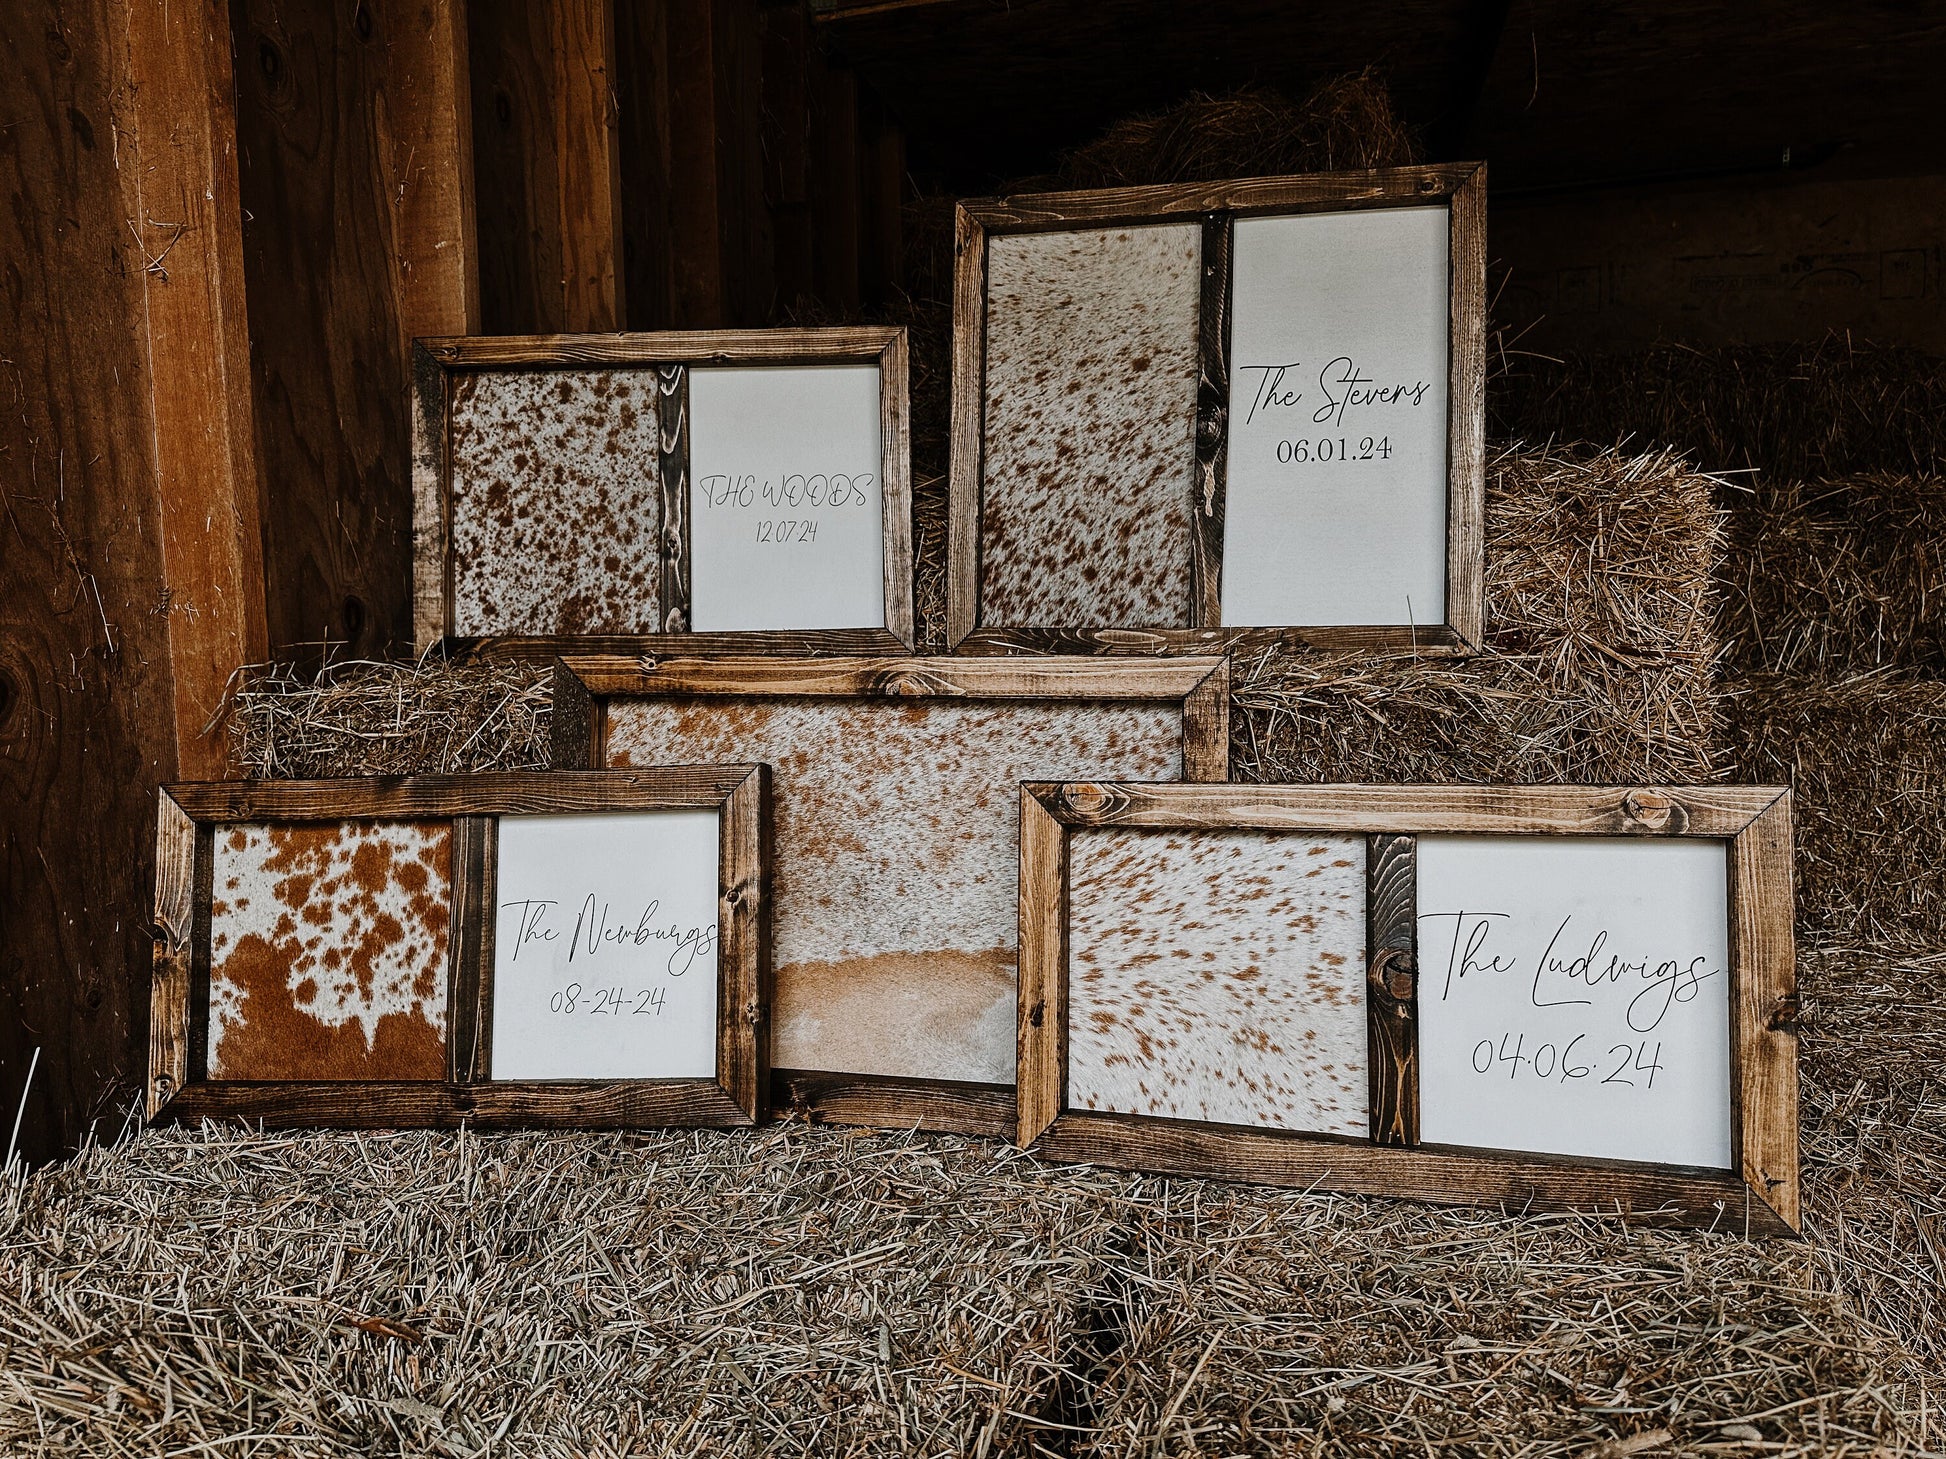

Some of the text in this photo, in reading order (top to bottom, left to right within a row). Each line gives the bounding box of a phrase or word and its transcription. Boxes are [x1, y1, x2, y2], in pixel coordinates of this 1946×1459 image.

[1240, 356, 1430, 427] The Stevens
[1277, 436, 1392, 463] 06.01.24
[700, 473, 874, 508] THE WOODS
[501, 893, 718, 976] The Newburgs
[1418, 910, 1719, 1032] The Ludwigs
[551, 983, 665, 1015] 08-24-24
